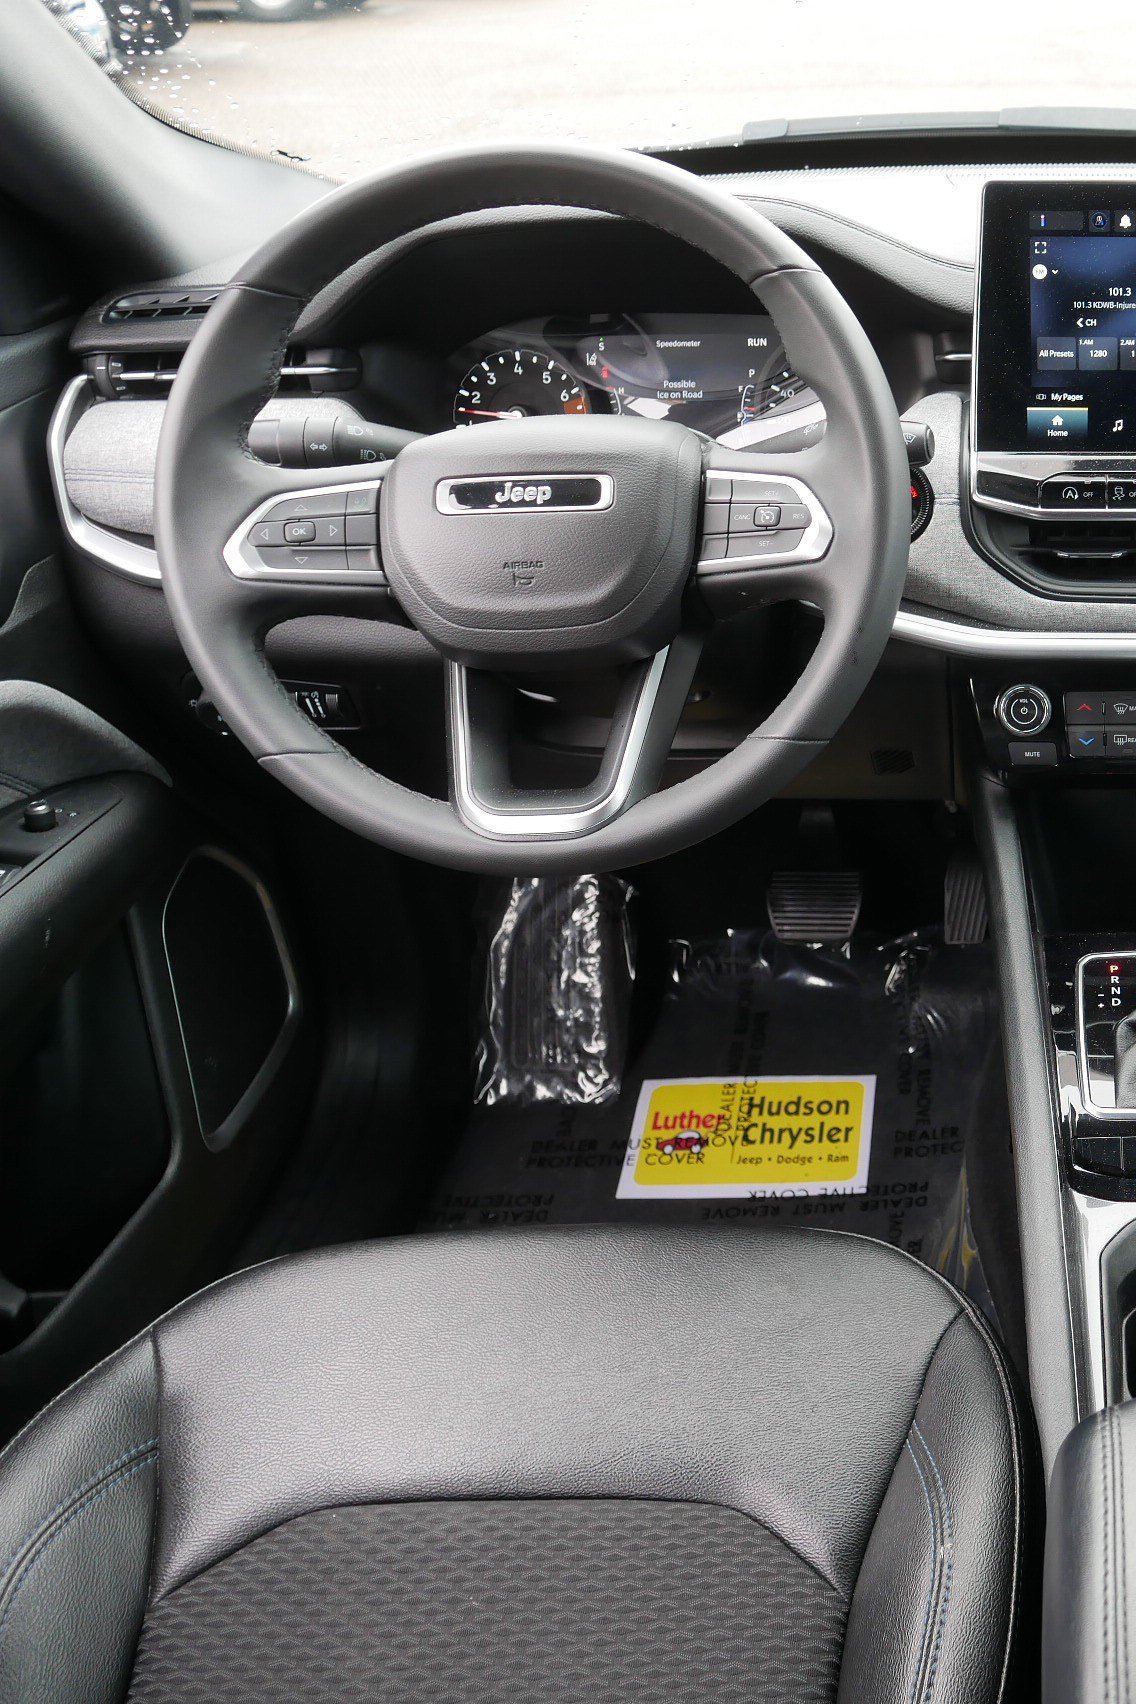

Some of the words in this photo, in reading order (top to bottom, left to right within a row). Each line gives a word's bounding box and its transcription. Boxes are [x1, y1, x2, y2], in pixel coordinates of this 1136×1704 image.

[1108, 287, 1132, 297] 101.3
[1073, 301, 1092, 309] 101.3
[1085, 319, 1097, 327] CH
[656, 340, 701, 349] Speedometer
[747, 338, 768, 347] RUN
[1039, 350, 1049, 358] All
[1049, 350, 1075, 358] Presets
[1089, 350, 1108, 358] 1280
[513, 362, 524, 375] 4
[748, 369, 756, 378] P
[486, 372, 497, 385] 3
[542, 371, 552, 384] 5
[663, 380, 696, 389] Possible
[471, 391, 481, 404] 2
[560, 389, 570, 402] 6
[657, 390, 669, 399] Ice
[669, 391, 681, 399] on
[682, 390, 703, 399] Road
[780, 389, 795, 398] 40
[1051, 393, 1063, 402] My
[1063, 393, 1084, 402] Pages
[1047, 429, 1068, 437] Home
[494, 481, 553, 505] Jeep
[292, 527, 307, 536] OK
[502, 560, 545, 570] AIRBAG
[1109, 964, 1119, 974] P
[1110, 975, 1120, 984] R
[1111, 986, 1121, 995] N
[1111, 998, 1121, 1007] D
[745, 1095, 850, 1117] Hudson
[651, 1110, 725, 1131] Luther
[741, 1121, 854, 1150] Chrysler
[894, 1126, 960, 1143] DEALER
[892, 1139, 965, 1159] PROTEC
[645, 1152, 706, 1166] COVER
[736, 1154, 763, 1166] Jeep
[776, 1154, 814, 1165] Dodge
[827, 1153, 849, 1163] Ram
[791, 1201, 846, 1217] MUST
[858, 1195, 929, 1213] DEALER
[700, 1204, 780, 1221] REMOVE
